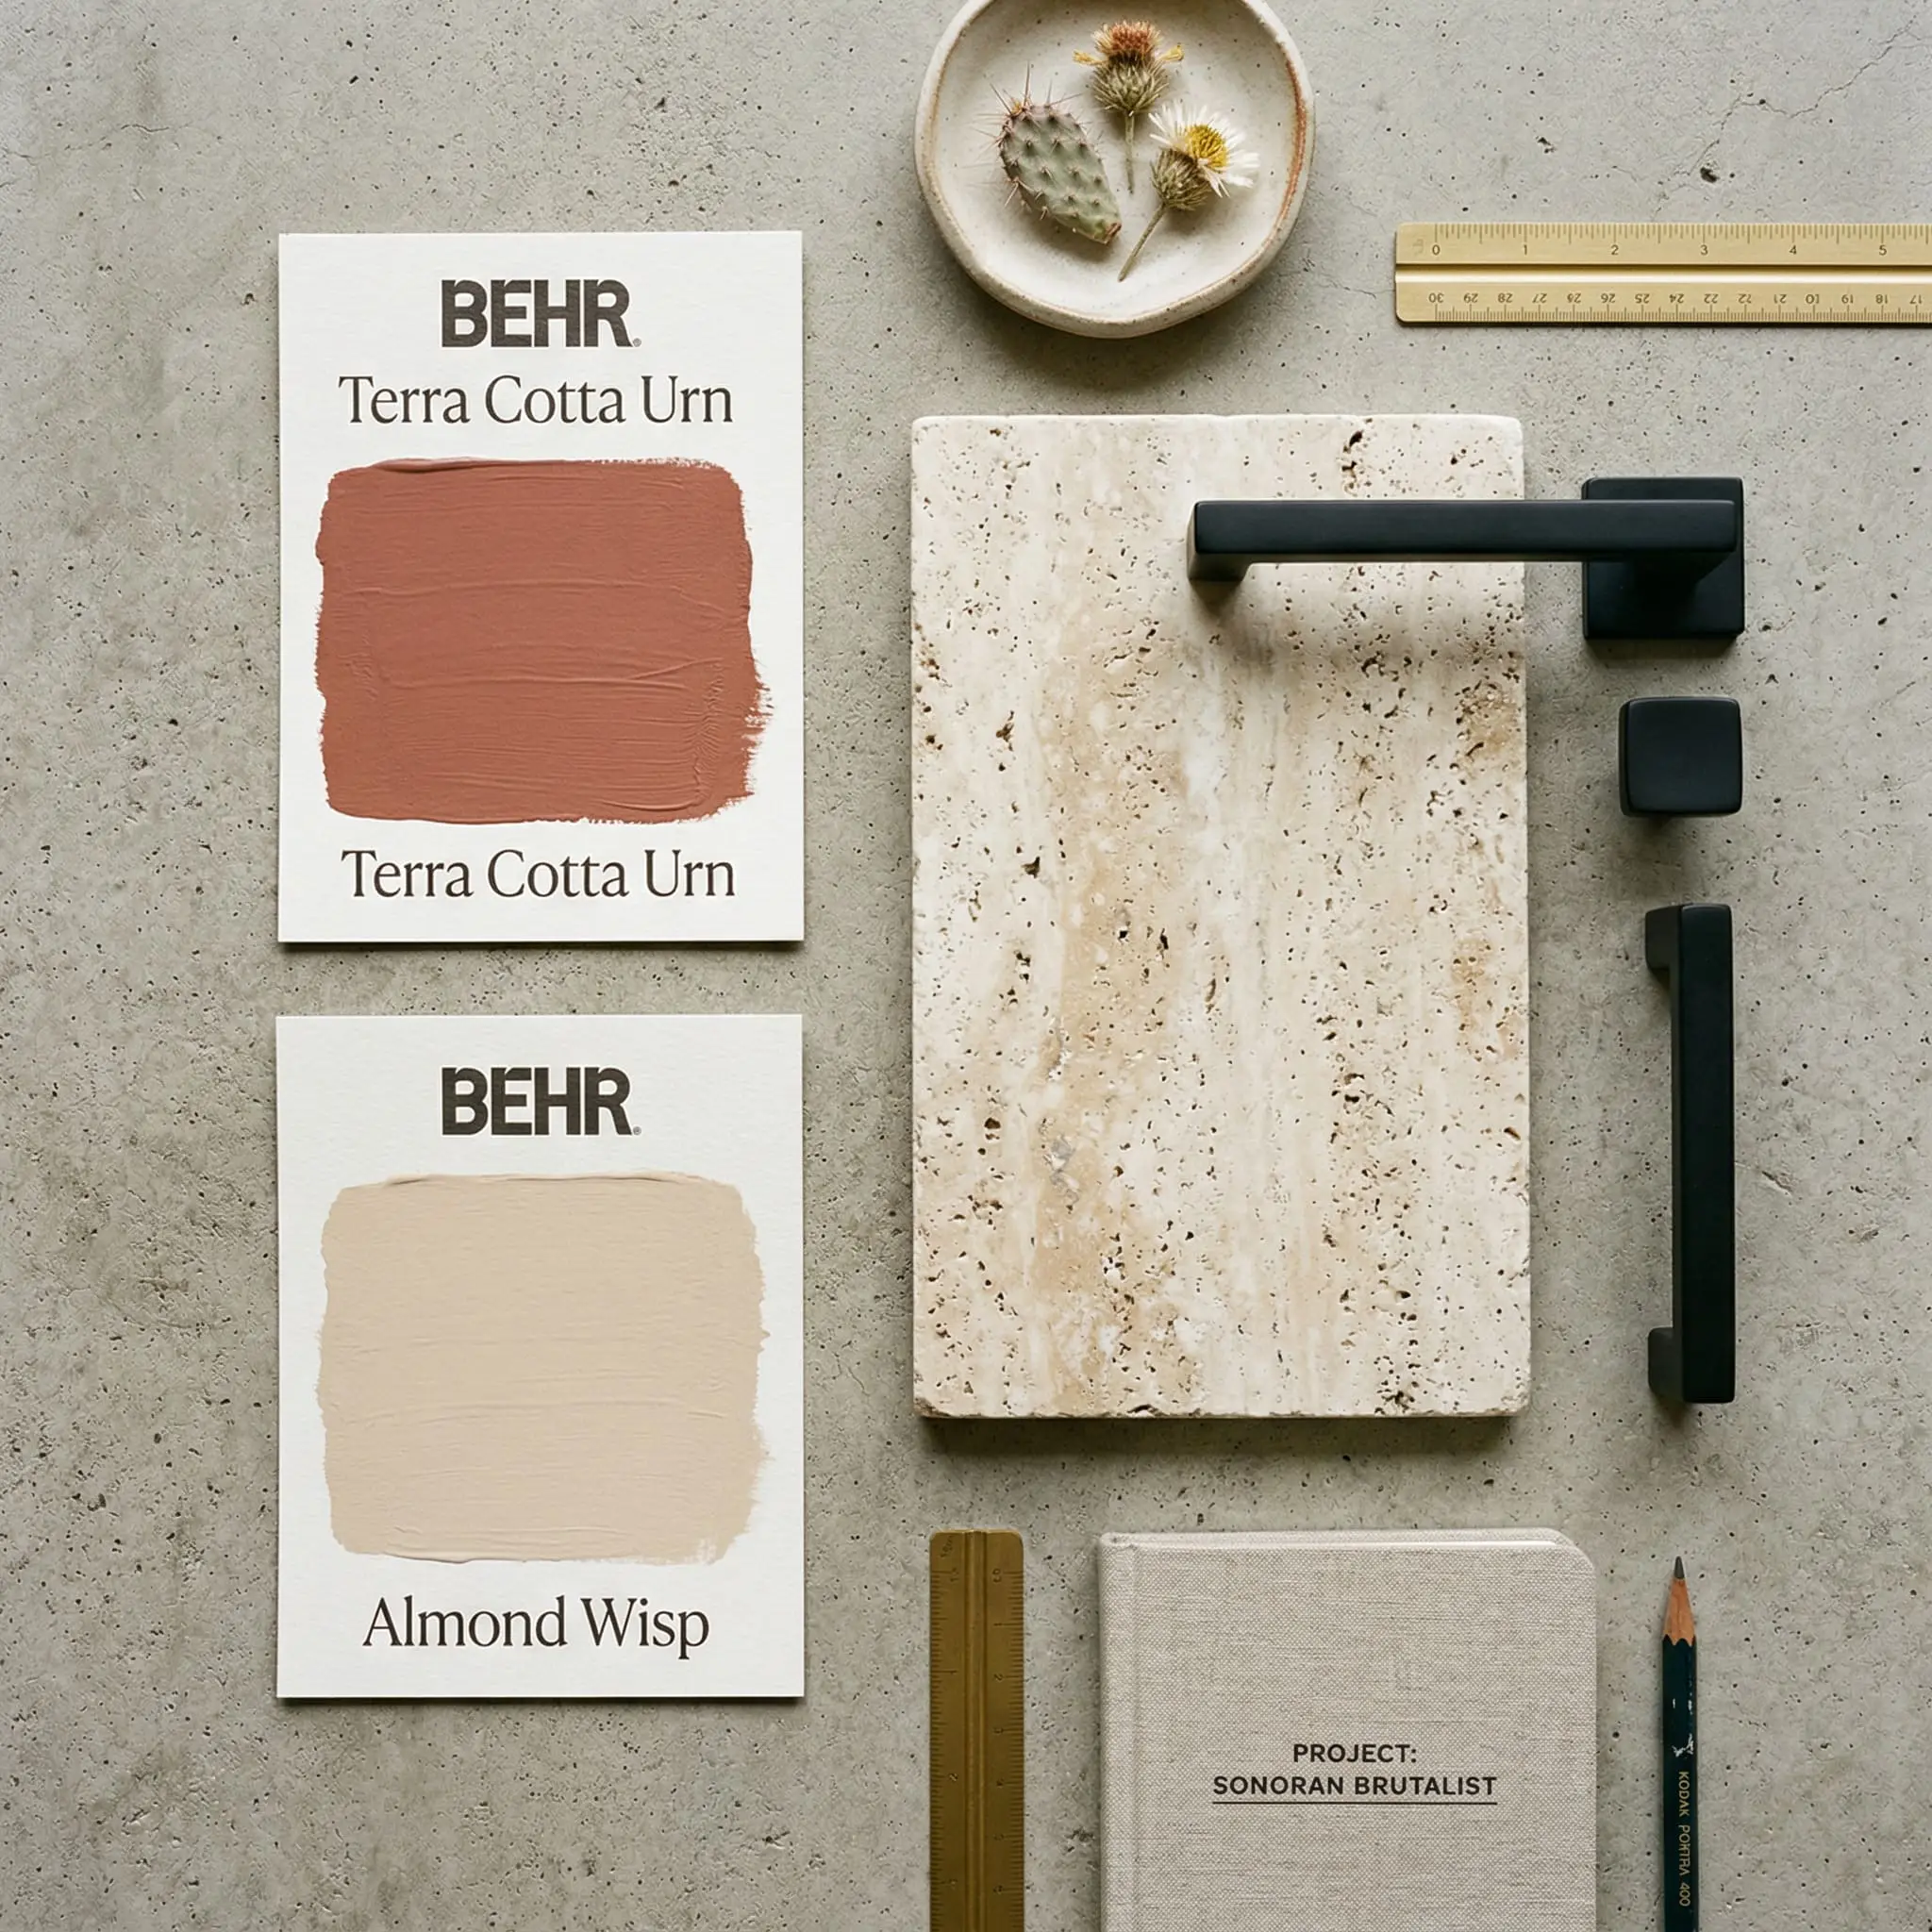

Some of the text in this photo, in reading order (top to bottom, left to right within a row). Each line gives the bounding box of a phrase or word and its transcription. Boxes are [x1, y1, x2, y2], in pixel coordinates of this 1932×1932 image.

[1432, 244, 1441, 256] 0
[1611, 244, 1619, 256] 2
[1701, 244, 1708, 256] 3
[1790, 244, 1797, 256] 4
[1879, 244, 1887, 256] 5
[1428, 293, 1444, 304] 30
[1463, 293, 1478, 304] 29
[1498, 293, 1513, 304] 28
[1532, 293, 1547, 304] 27
[1601, 293, 1616, 304] 26
[1635, 293, 1650, 304] 25
[1669, 293, 1685, 304] 24
[1876, 293, 1889, 304] 18
[441, 279, 633, 347] BEHR
[339, 375, 732, 424] Terra Cotta Urn
[341, 850, 734, 897] Terra Cotta Urn
[442, 1067, 633, 1135] BEHR
[363, 1595, 708, 1659] Almond Wisp
[1293, 1743, 1417, 1763] PROJECT:
[1213, 1775, 1497, 1795] SONORAN BRUTALIST
[1678, 1771, 1690, 1817] KODAK
[1679, 1882, 1691, 1907] 400
